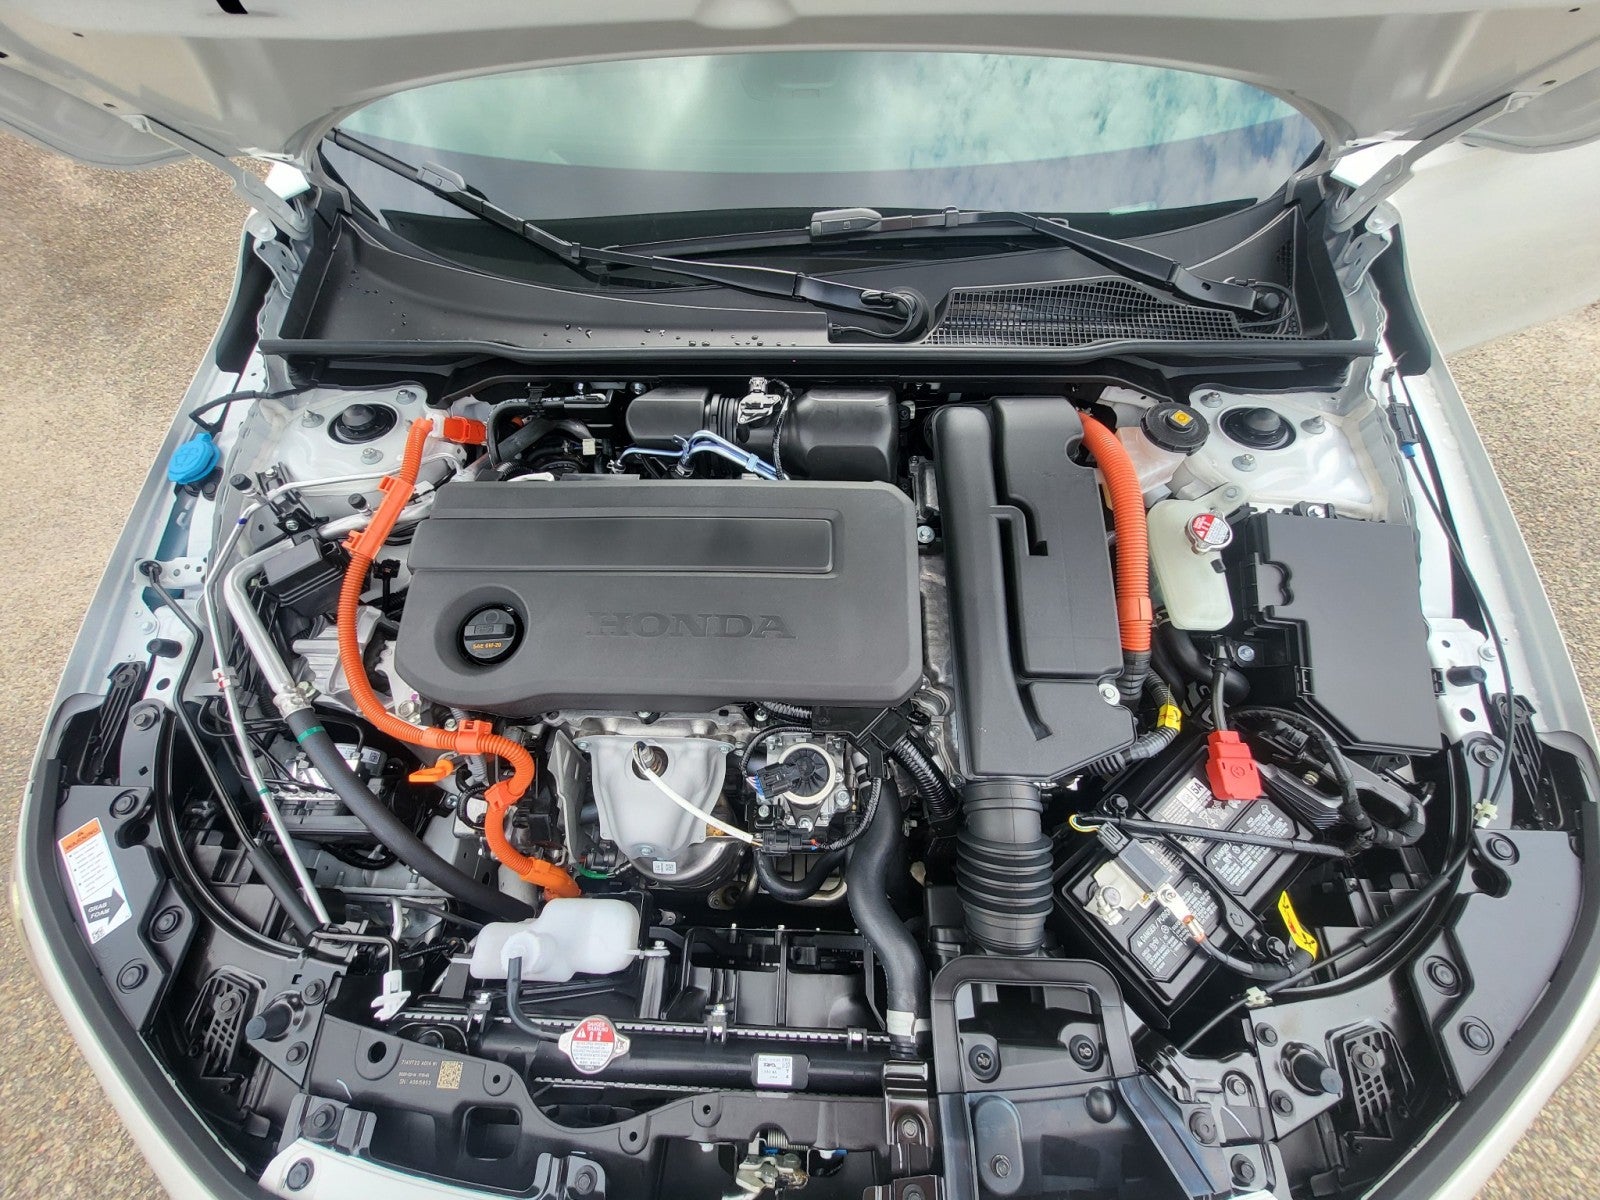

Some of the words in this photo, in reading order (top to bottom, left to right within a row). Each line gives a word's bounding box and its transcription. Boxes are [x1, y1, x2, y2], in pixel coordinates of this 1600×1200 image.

[584, 611, 798, 639] HONDA
[65, 828, 99, 850] WARNING
[88, 902, 108, 913] GRAB
[90, 908, 110, 919] FOAM
[1139, 922, 1157, 944] DANGER
